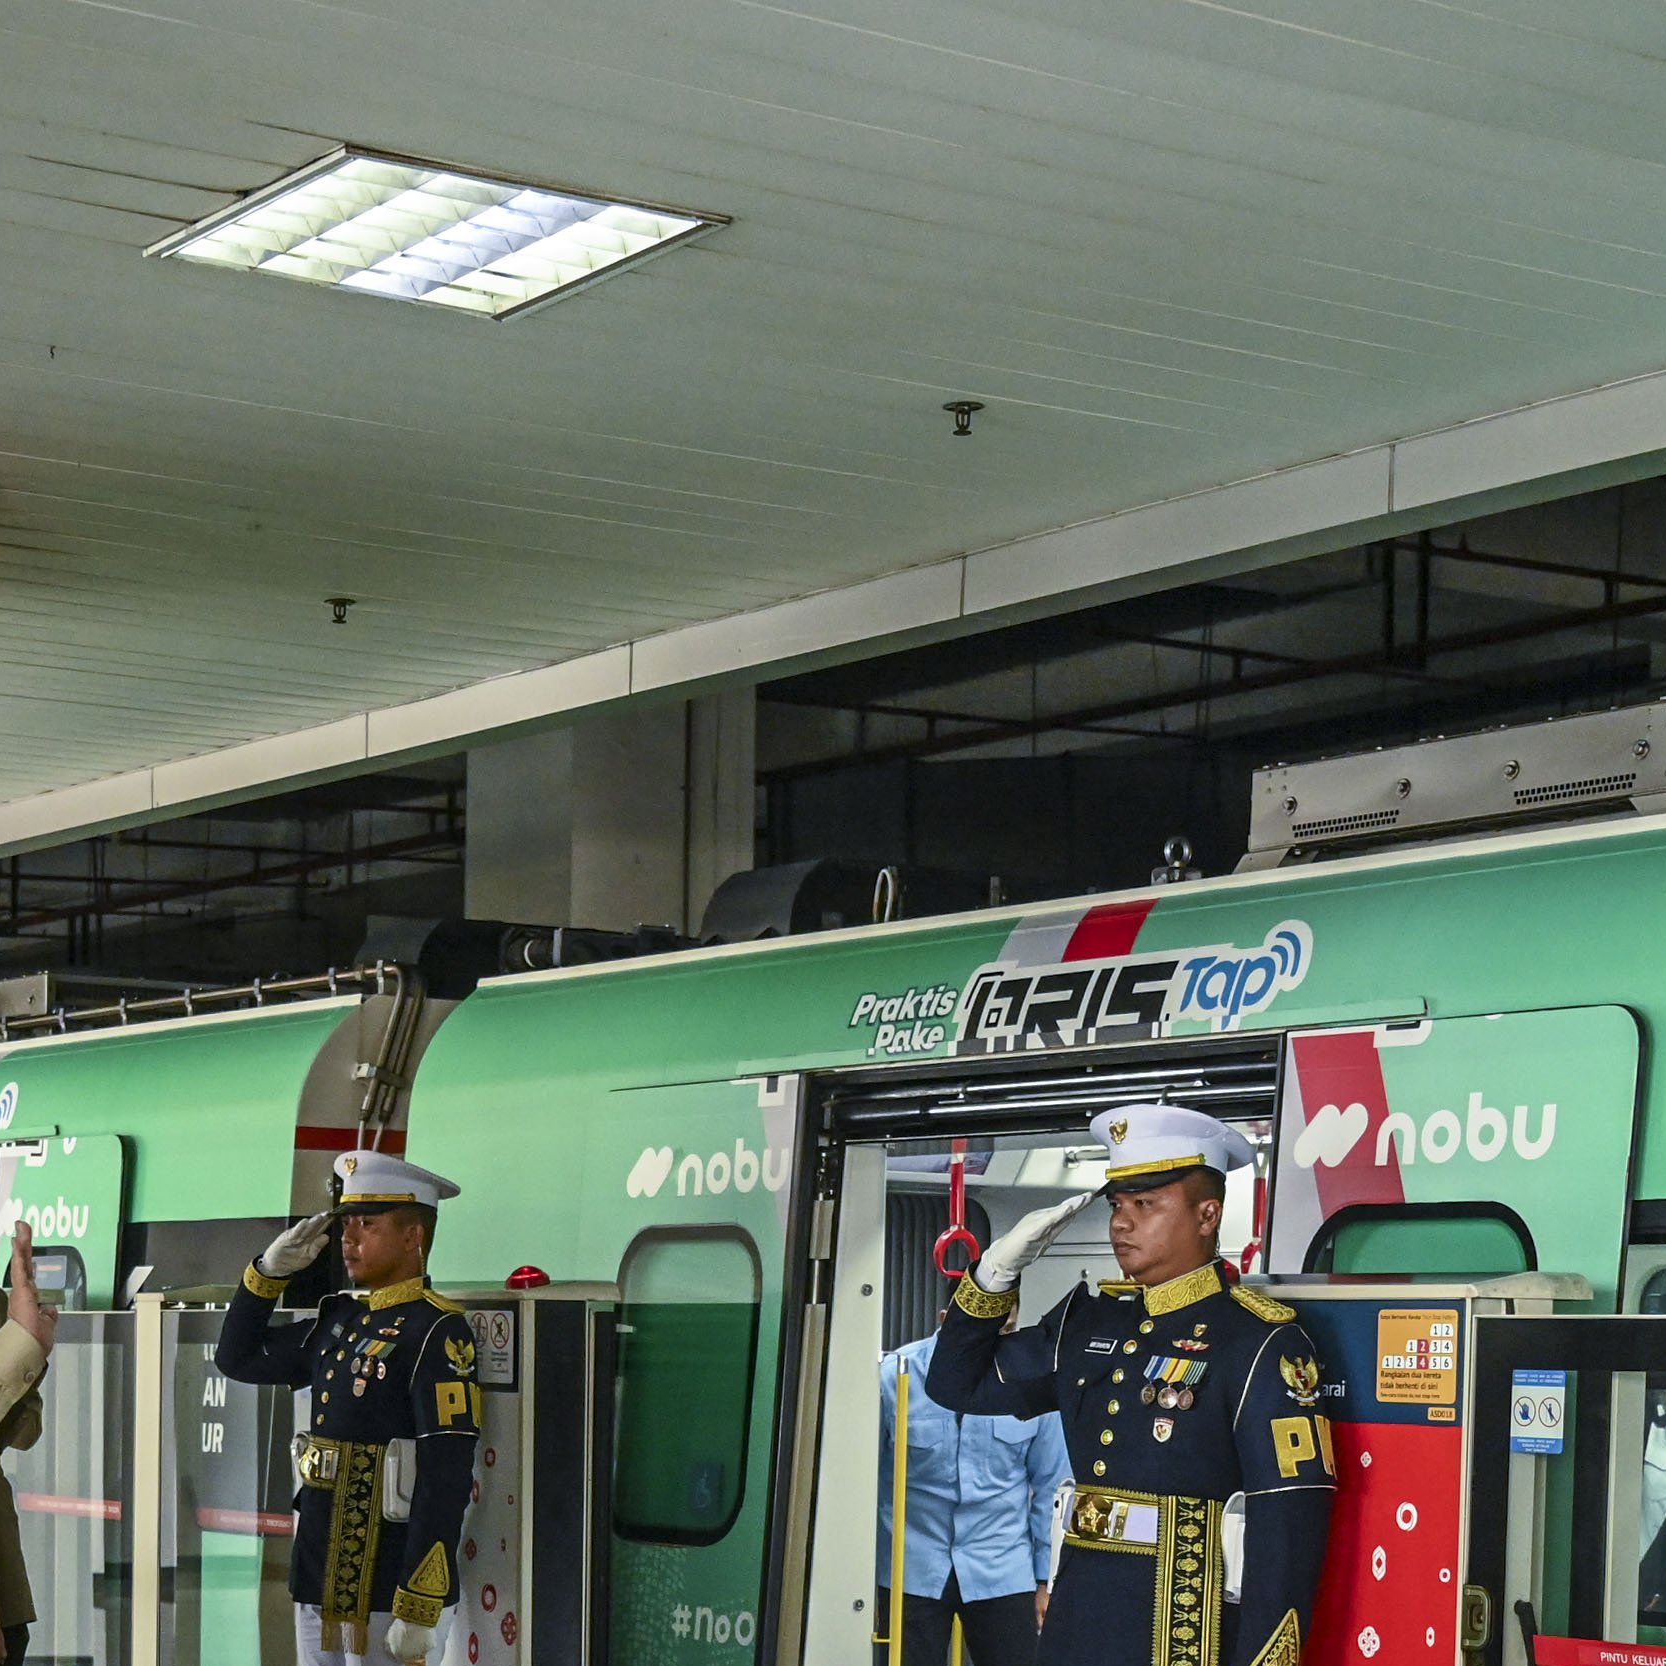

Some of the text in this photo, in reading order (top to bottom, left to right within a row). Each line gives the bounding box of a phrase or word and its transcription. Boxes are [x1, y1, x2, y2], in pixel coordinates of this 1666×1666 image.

[850, 984, 958, 1026] Praktis
[1179, 955, 1277, 1031] Tap
[867, 1020, 944, 1056] Pake
[1374, 1092, 1557, 1166] nobu
[676, 1137, 791, 1196] nobu
[24, 1196, 89, 1239] nobu
[1322, 1380, 1346, 1397] arai
[1600, 1651, 1628, 1664] PINTU
